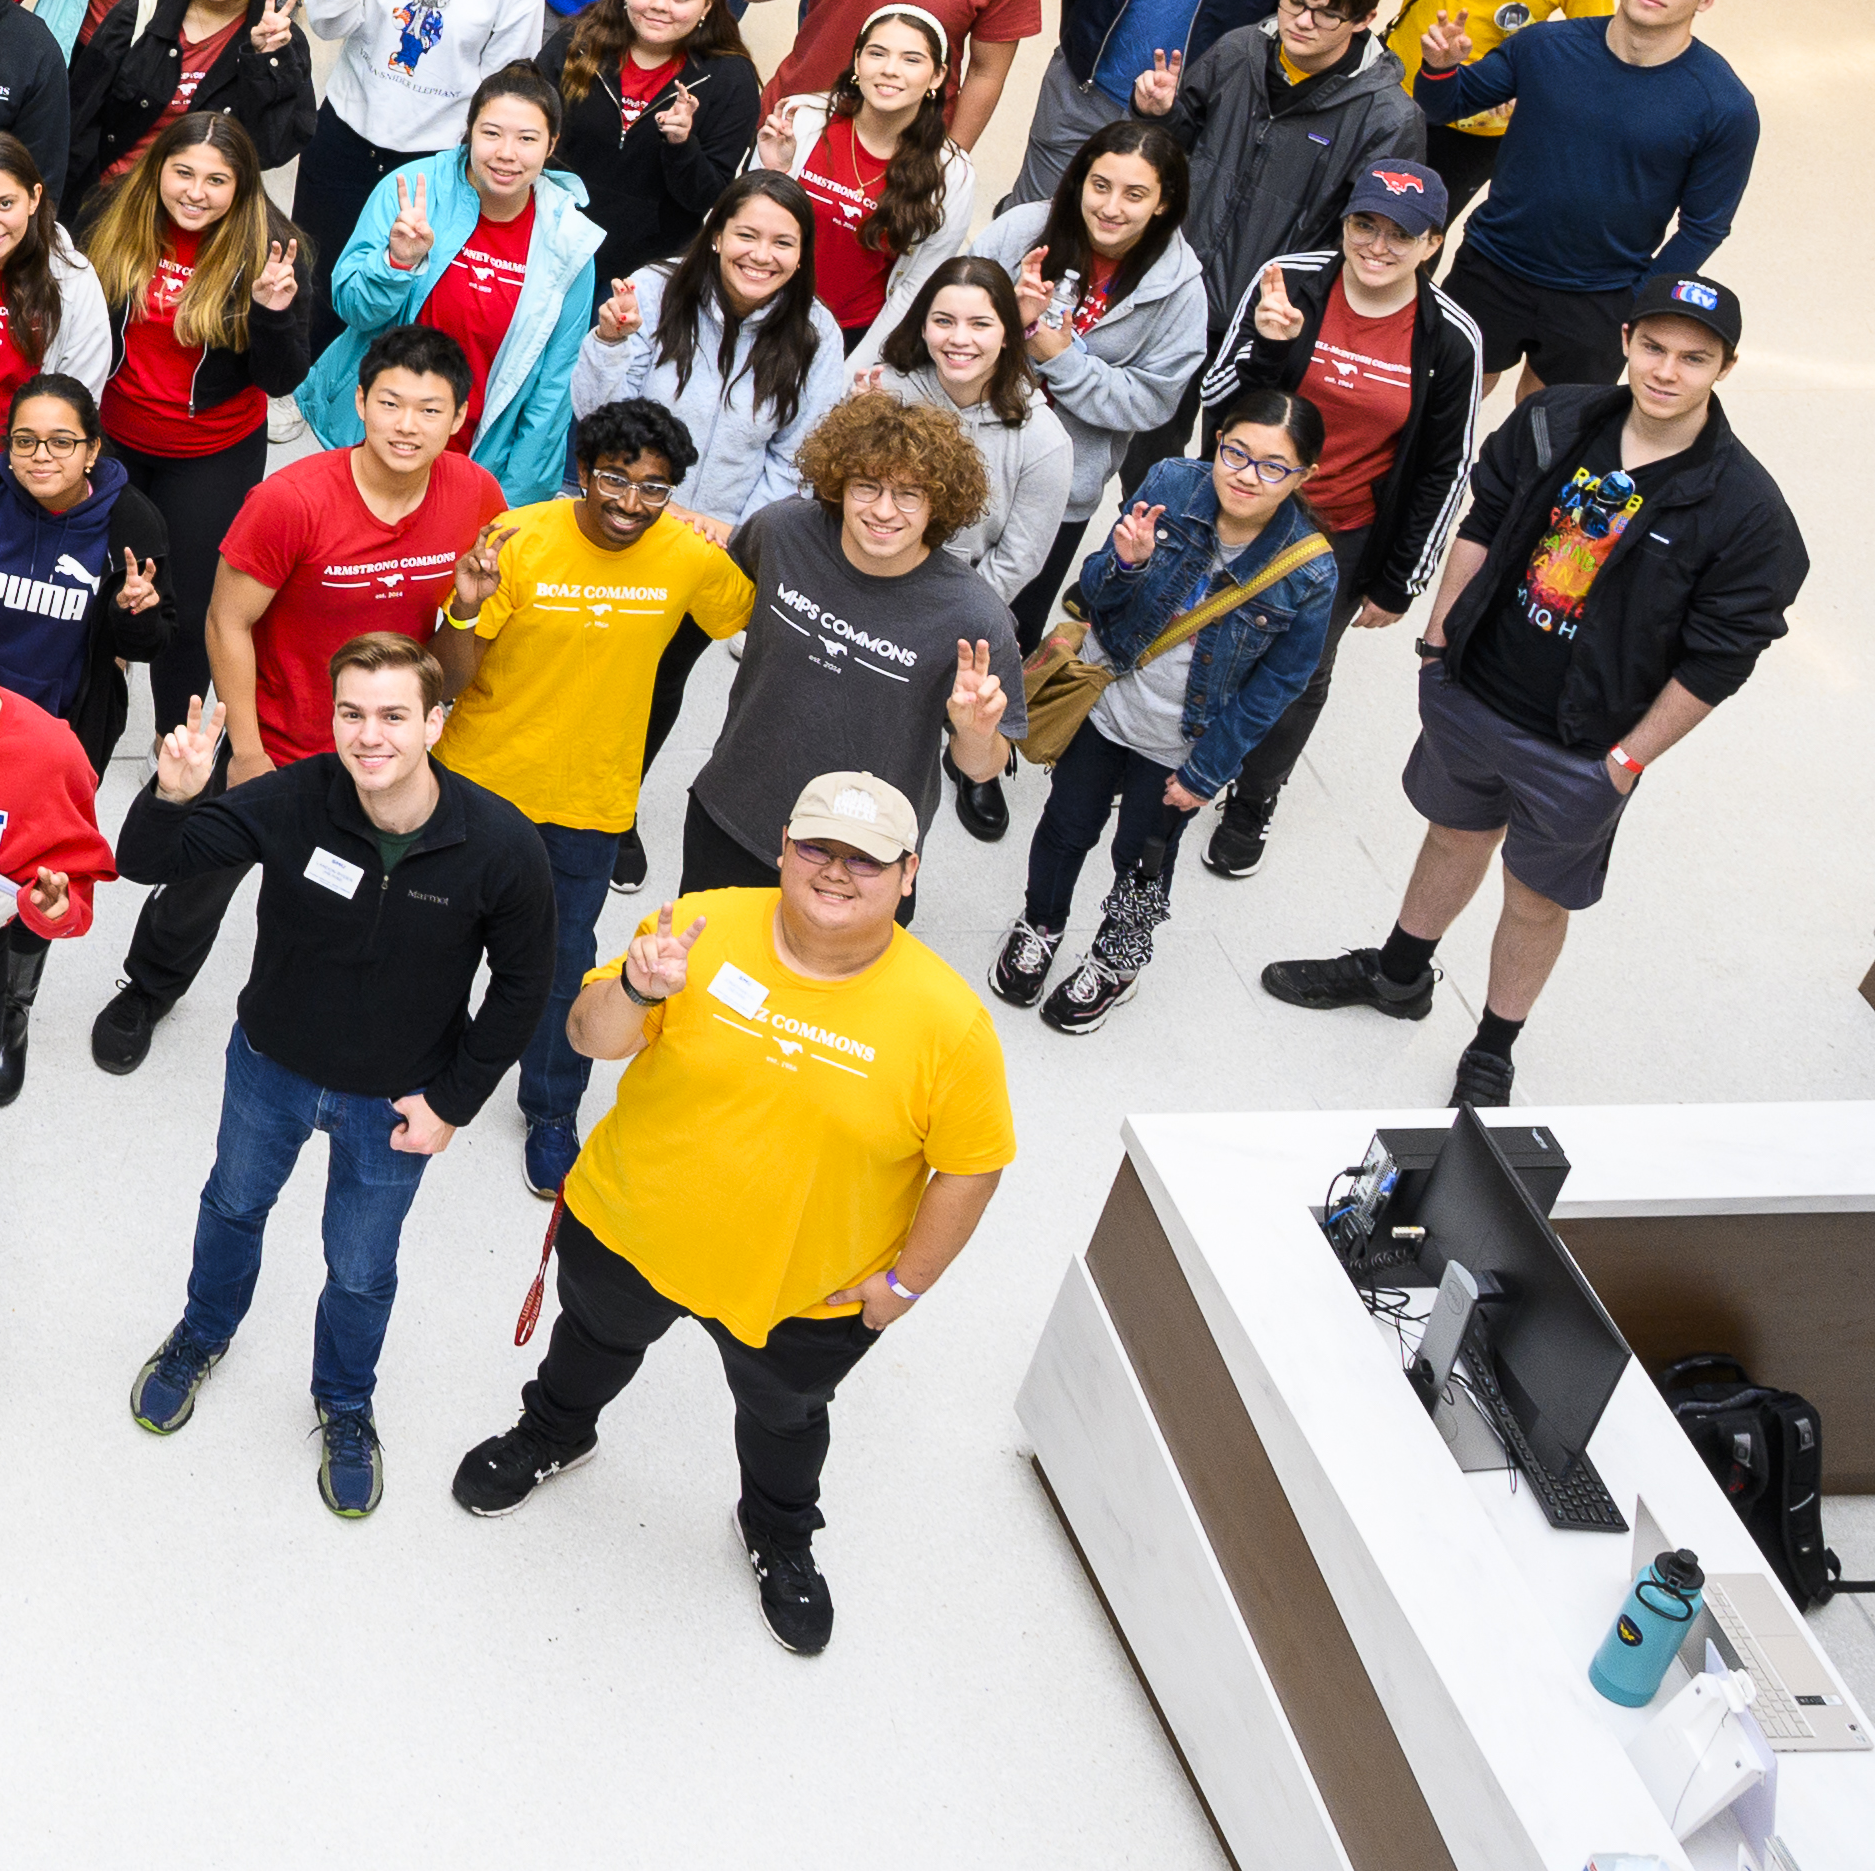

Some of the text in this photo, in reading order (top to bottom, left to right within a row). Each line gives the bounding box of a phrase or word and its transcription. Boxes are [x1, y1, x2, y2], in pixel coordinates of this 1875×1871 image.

[323, 551, 457, 576] ARMSTRONG COMMONS
[536, 582, 668, 601] BOAZ COMMONS
[776, 582, 918, 668] MHPS COMMONS
[771, 1013, 877, 1063] COMMONS
